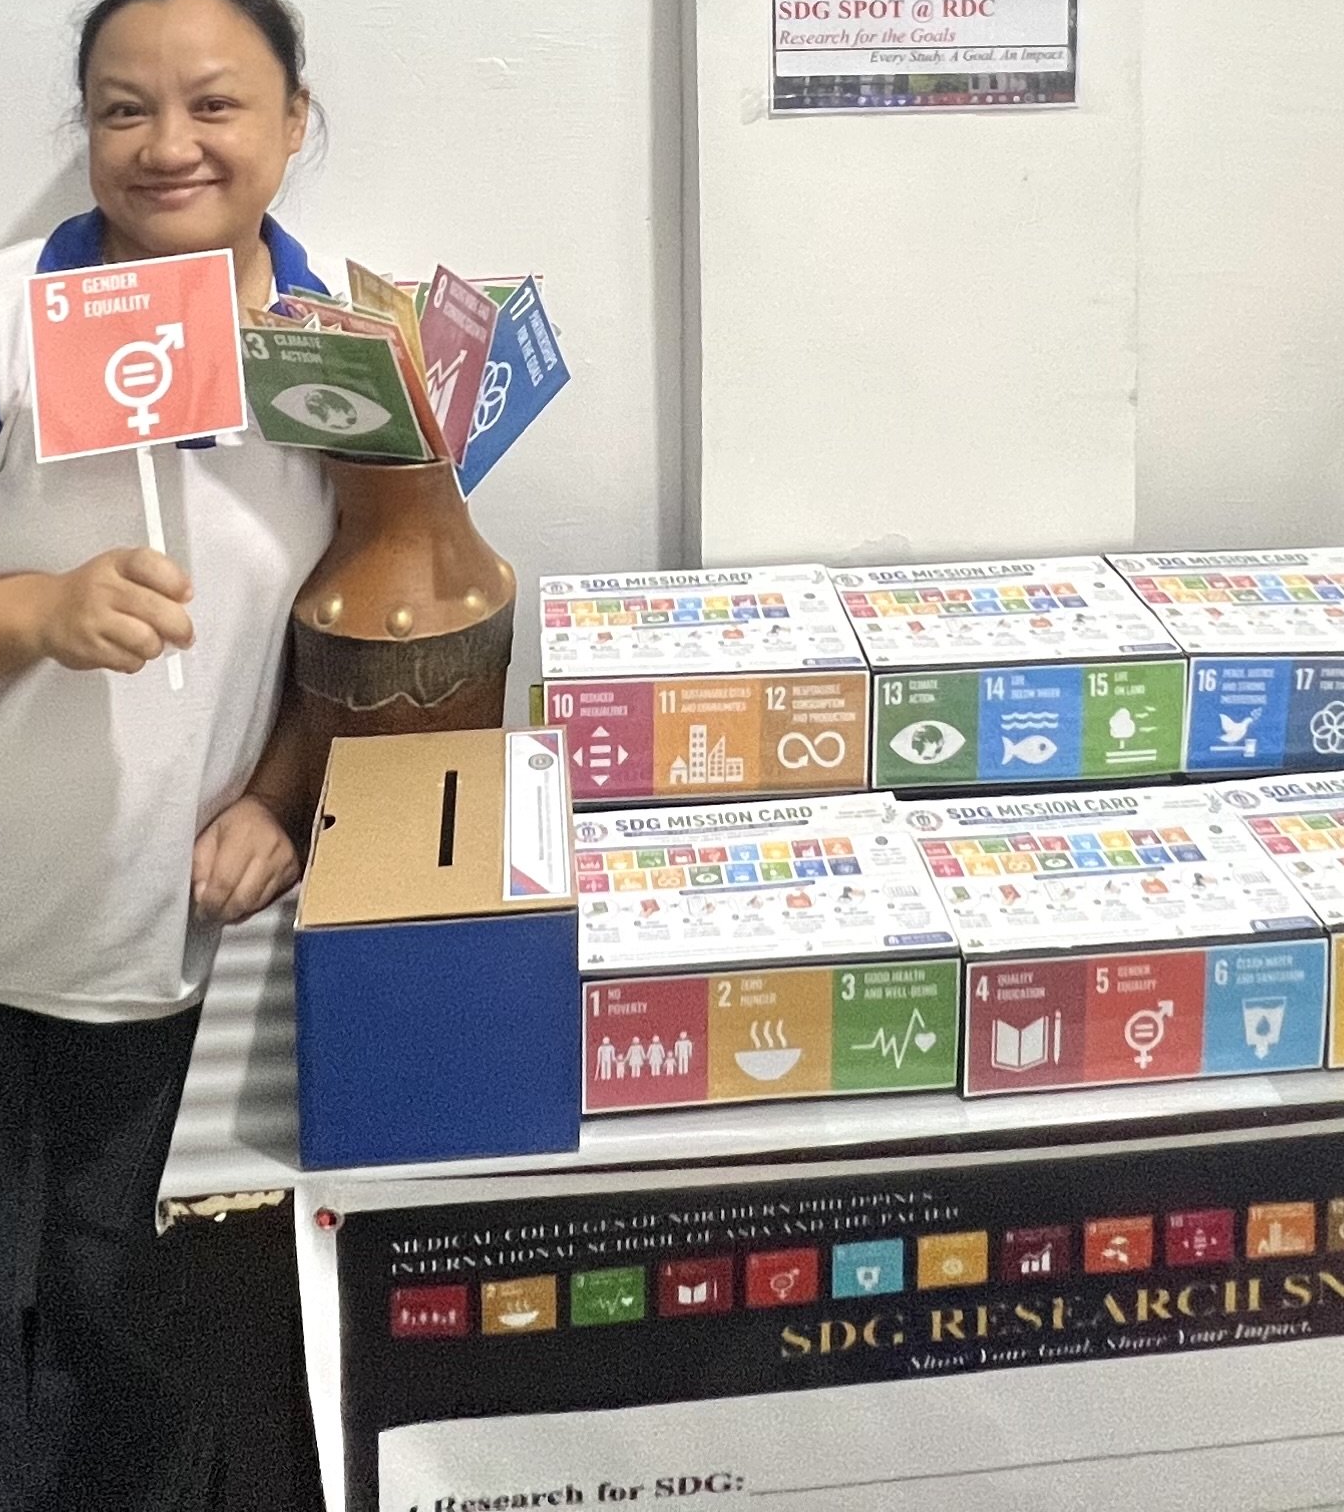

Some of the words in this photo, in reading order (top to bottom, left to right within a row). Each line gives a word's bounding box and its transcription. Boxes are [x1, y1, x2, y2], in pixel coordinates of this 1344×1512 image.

[779, 0, 830, 20] SDG
[838, 0, 905, 19] SPOT
[911, 0, 934, 23] @
[779, 30, 849, 45] Research
[852, 29, 877, 47] for
[882, 29, 906, 44] the
[911, 27, 956, 44] Goals
[870, 51, 904, 65] Every
[949, 51, 959, 62] A
[1001, 50, 1017, 61] An
[82, 272, 138, 295] GENDER
[434, 274, 448, 308] 8
[46, 282, 69, 322] 5
[84, 294, 151, 318] EQUALITY
[510, 286, 535, 321] 17
[1147, 556, 1186, 567] SDG
[1190, 554, 1260, 565] MISSION
[1264, 553, 1308, 564] CARD
[580, 579, 620, 589] SDG
[626, 575, 699, 587] MISSION
[706, 572, 753, 584] CARD
[868, 571, 906, 582] SDG
[912, 566, 984, 580] MISSION
[988, 563, 1036, 575] CARD
[984, 677, 1005, 701] 14
[1087, 672, 1109, 697] 15
[1197, 669, 1217, 692] 16
[1296, 668, 1315, 691] 17
[659, 690, 677, 713] 11
[765, 686, 786, 711] 12
[882, 681, 903, 705] 13
[552, 693, 573, 718] 10
[1259, 784, 1305, 799] SDG
[616, 817, 661, 833] SDG
[667, 811, 753, 829] MISSION
[759, 806, 813, 823] CARD
[946, 806, 993, 820] SDG
[997, 800, 1082, 818] MISSION
[1084, 796, 1139, 812] CARD
[1096, 968, 1109, 993] 5
[1215, 960, 1228, 985] 6
[718, 981, 732, 1008] 2
[841, 974, 856, 1001] 3
[976, 976, 990, 1001] 4
[590, 991, 601, 1017] 1
[781, 1314, 904, 1358] SDG
[930, 1278, 1263, 1342] RESEARCH
[434, 1483, 584, 1512] Research
[597, 1481, 644, 1502] for
[655, 1472, 744, 1498] SDG:
